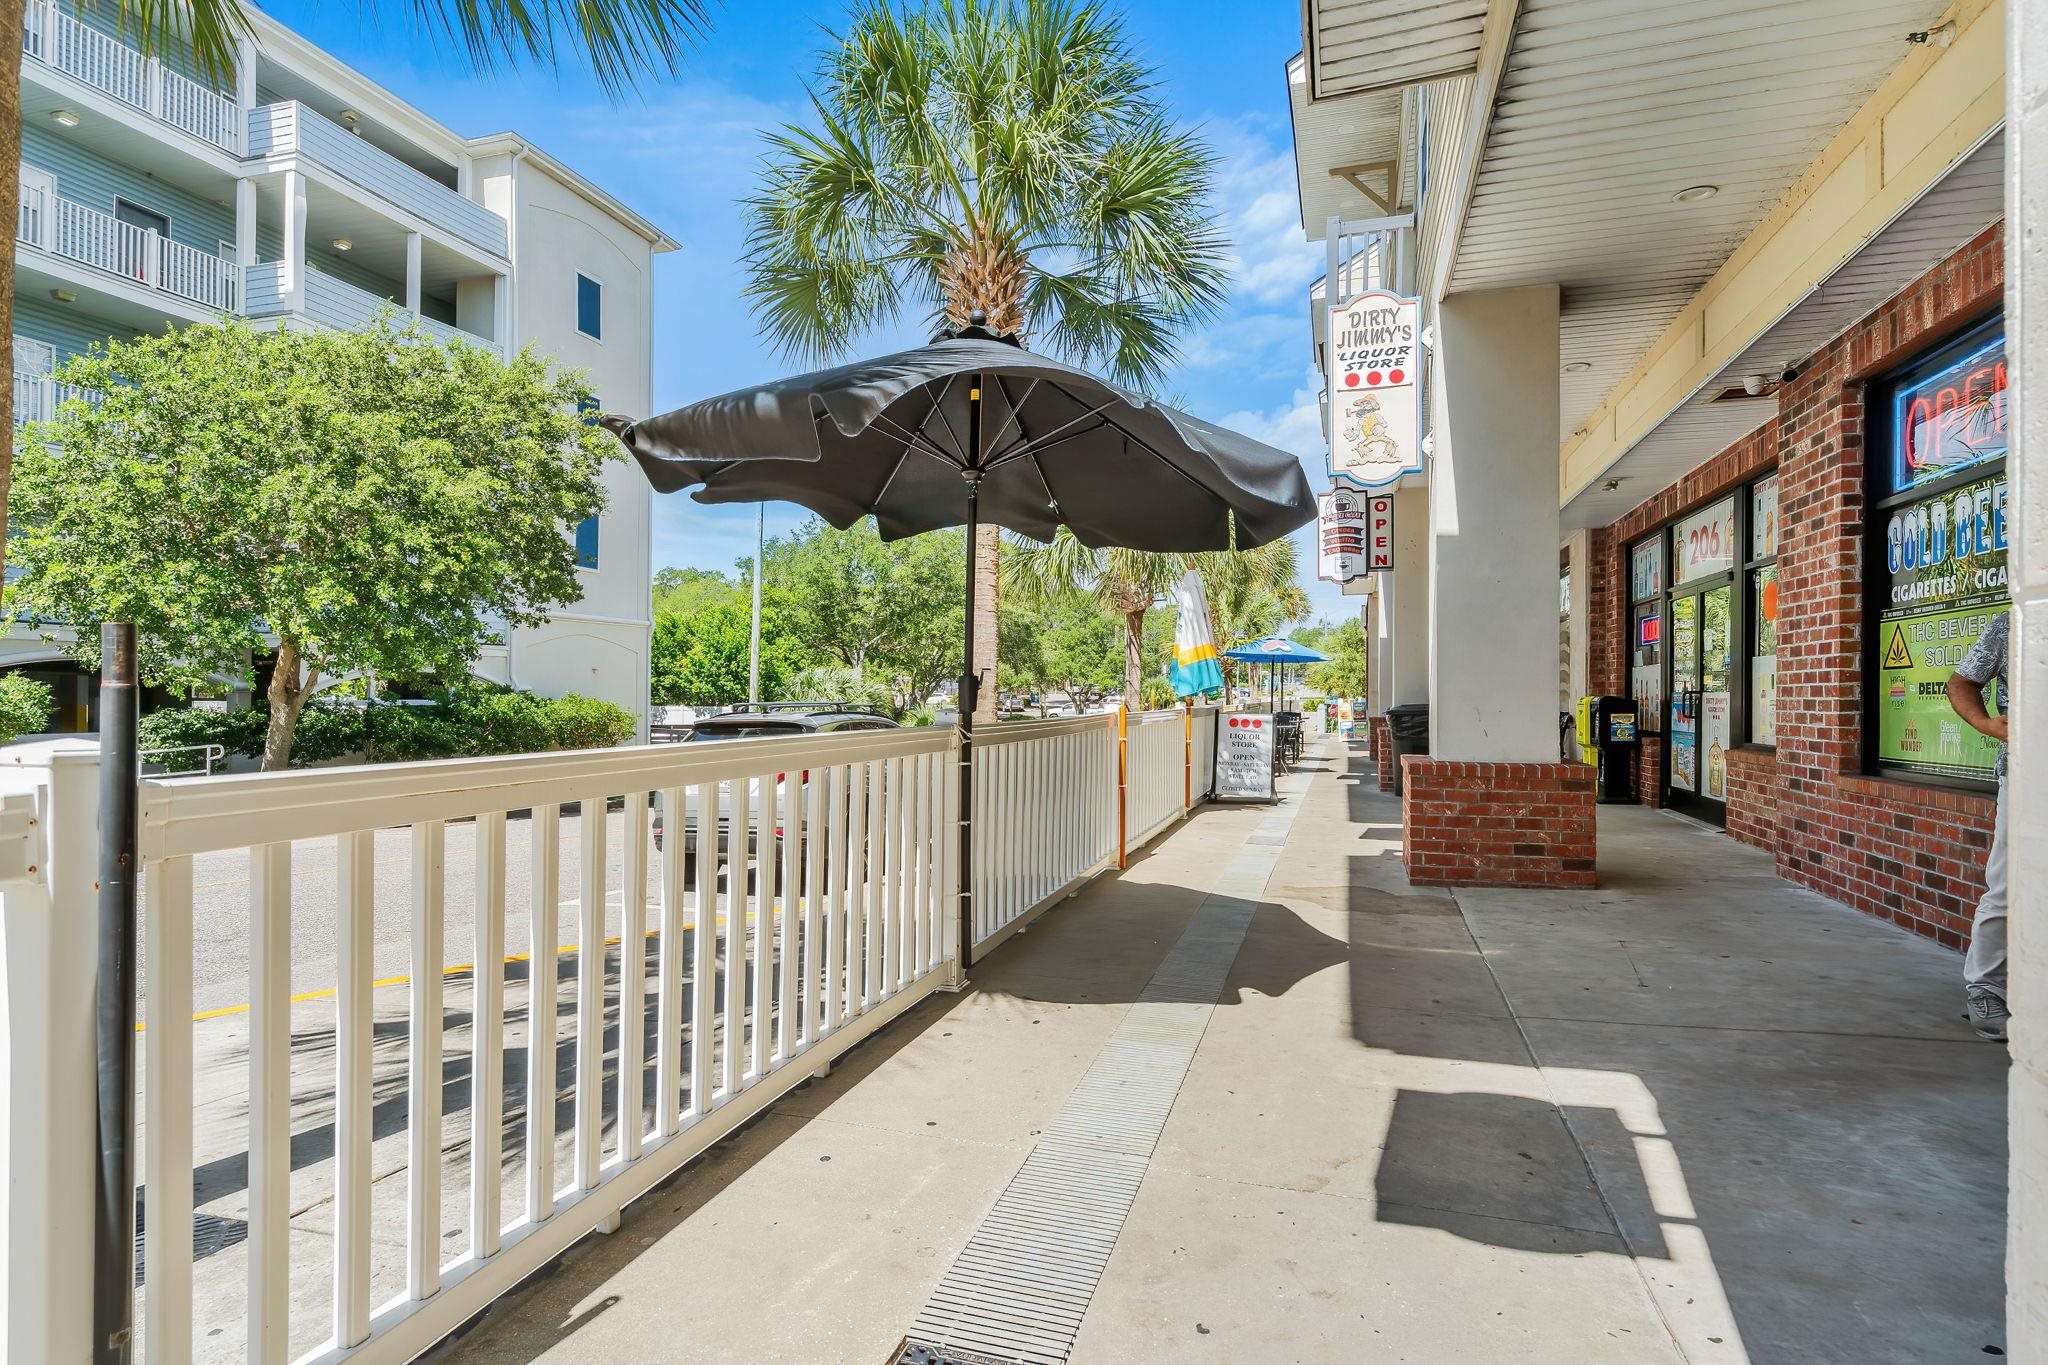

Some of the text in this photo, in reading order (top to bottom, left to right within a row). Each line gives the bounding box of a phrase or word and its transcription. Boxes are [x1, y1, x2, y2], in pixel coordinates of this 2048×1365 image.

[1349, 307, 1400, 329] DIRTY
[1337, 325, 1412, 349] JIMMY'S
[1339, 346, 1412, 361] LIQUOR
[1344, 357, 1405, 372] STORE
[1374, 501, 1387, 565] OPEN
[1690, 520, 1720, 566] 206
[1887, 501, 1947, 574] COLD
[1892, 575, 1957, 602] CIGARETTES
[1909, 609, 2008, 643] THC BEVER
[1925, 644, 1963, 667] SOLD
[1891, 676, 1906, 687] HIGH
[1919, 682, 1948, 695] DELTA
[1229, 733, 1260, 741] LIQUOR
